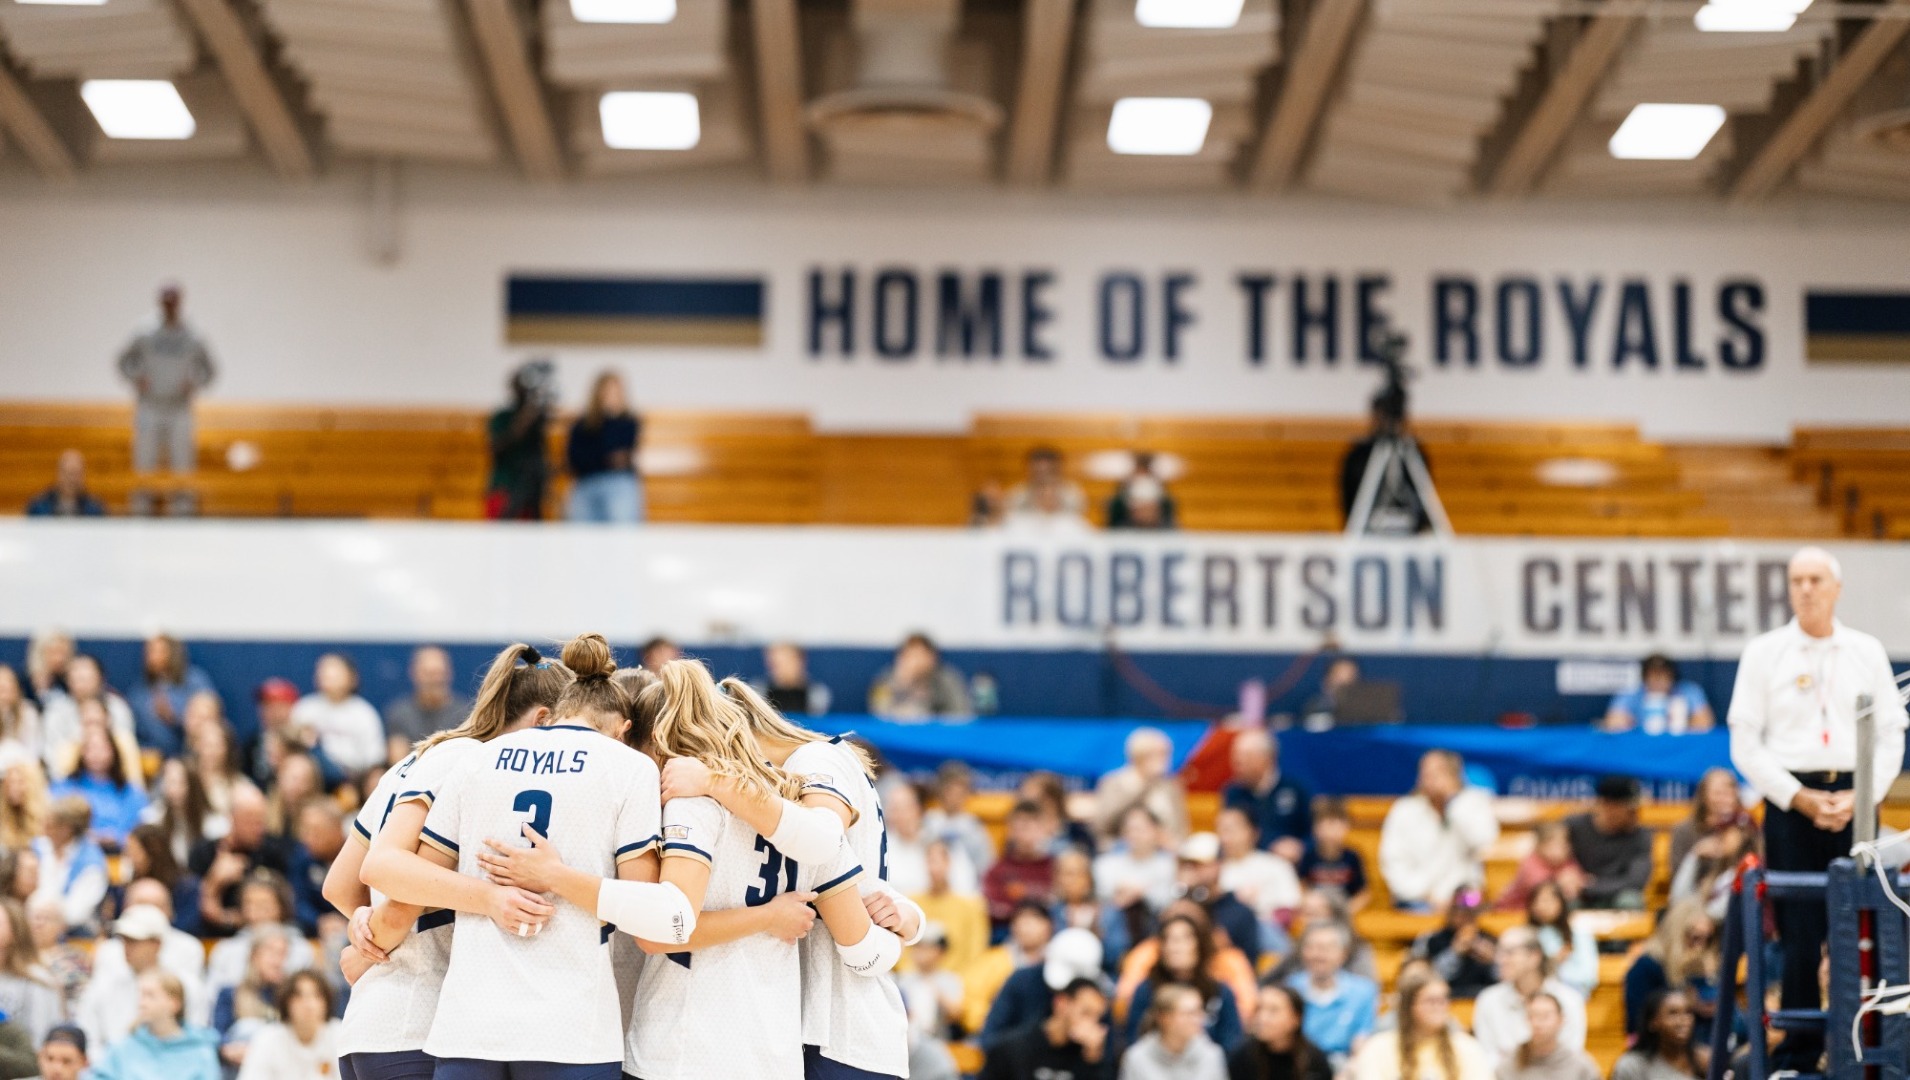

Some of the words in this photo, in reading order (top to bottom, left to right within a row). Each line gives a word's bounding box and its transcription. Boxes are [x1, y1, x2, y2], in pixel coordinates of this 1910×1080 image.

[807, 268, 1056, 363] HOME
[1097, 270, 1198, 366] OF
[1236, 271, 1393, 368] THE
[1431, 273, 1767, 372] ROYALS
[1002, 551, 1446, 633] ROBERTSON
[1521, 554, 1794, 637] CENTER
[495, 747, 588, 775] ROYALS
